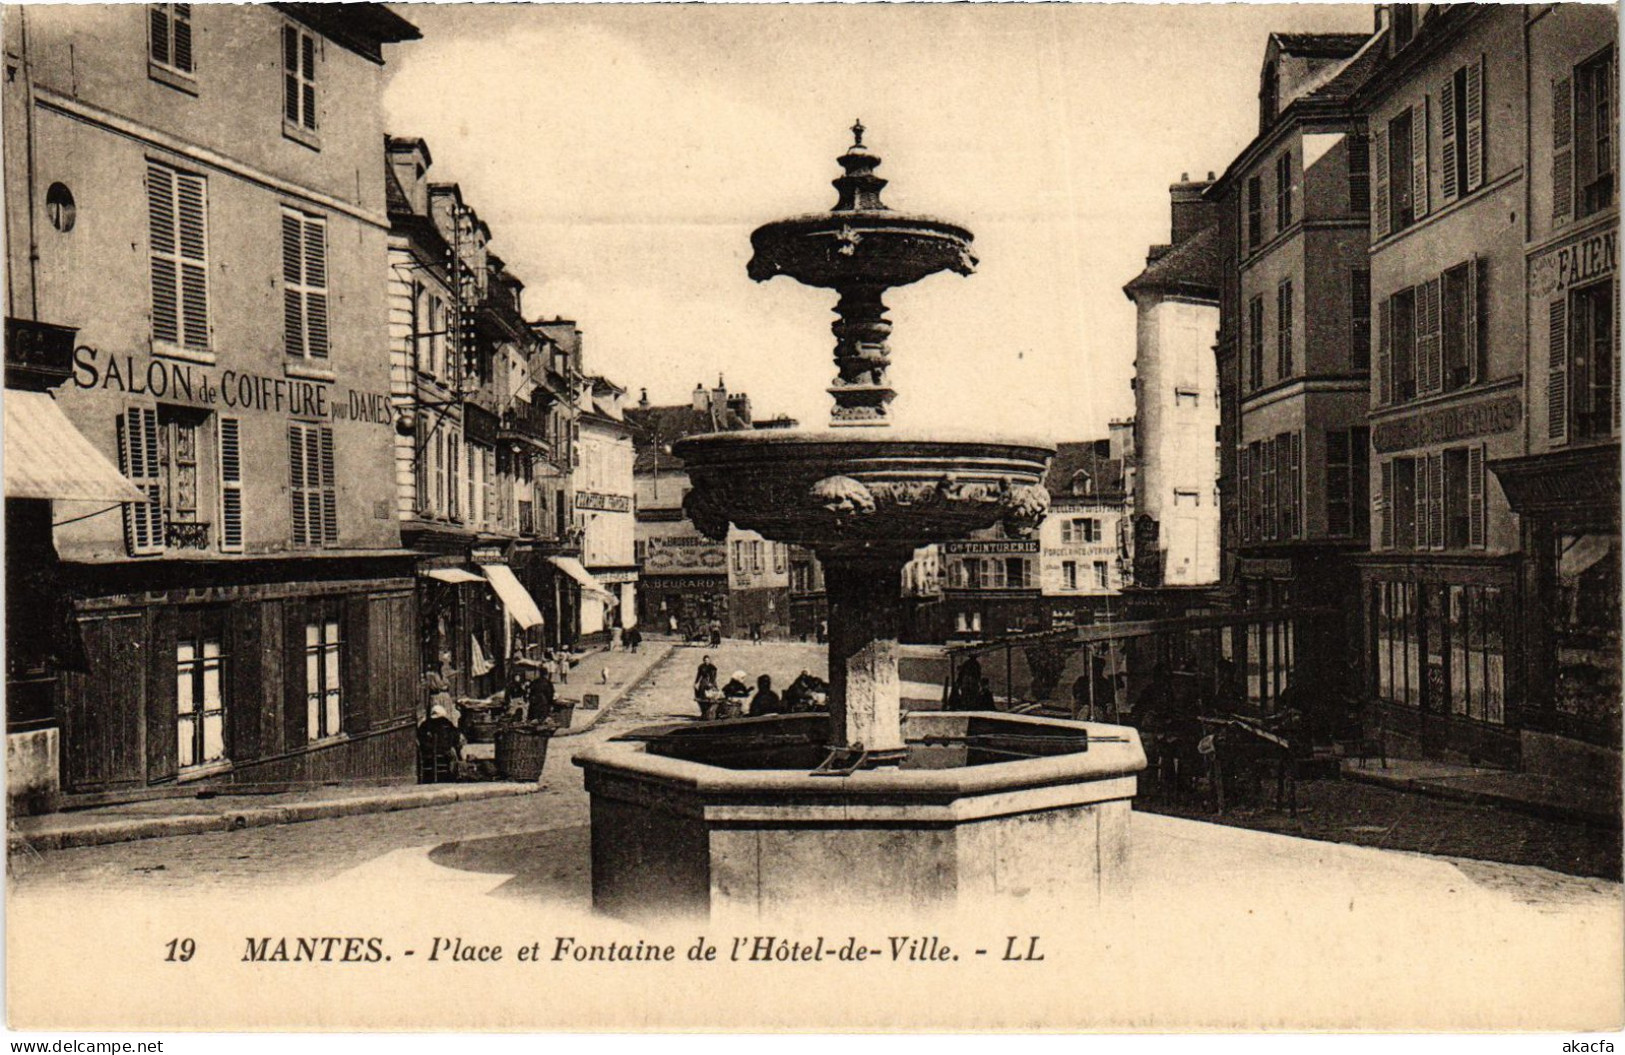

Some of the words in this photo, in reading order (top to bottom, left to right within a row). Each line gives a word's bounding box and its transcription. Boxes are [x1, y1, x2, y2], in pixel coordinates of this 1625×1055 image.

[1557, 230, 1618, 291] FAIEN
[73, 345, 193, 400] SALON
[199, 375, 217, 404] de
[221, 370, 328, 417] COIFFURE
[349, 389, 392, 425] DAMES
[965, 542, 1037, 553] TEINTURERIE
[654, 578, 714, 589] BEURARD
